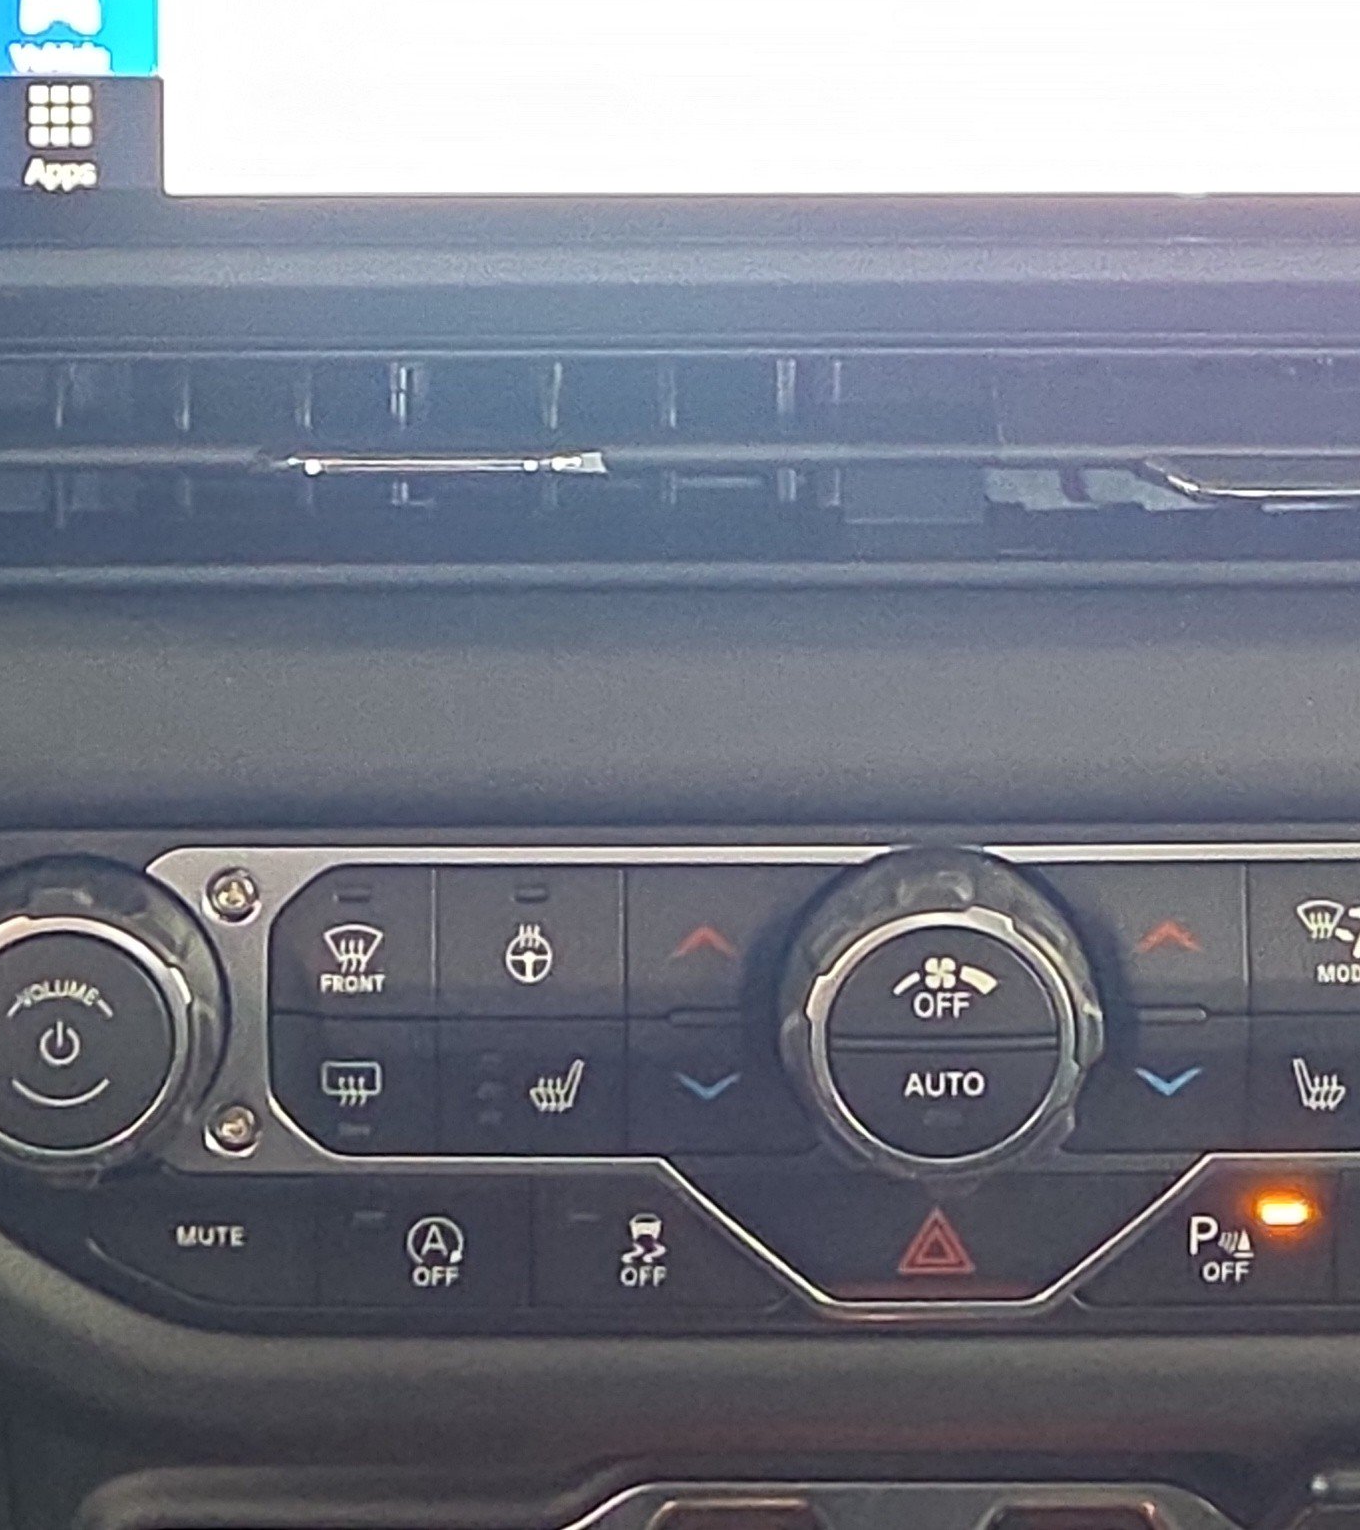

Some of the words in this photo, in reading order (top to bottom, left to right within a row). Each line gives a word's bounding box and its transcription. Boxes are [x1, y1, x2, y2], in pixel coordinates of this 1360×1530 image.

[25, 158, 97, 191] Apps
[16, 982, 96, 1008] VOLUME
[321, 974, 384, 993] FRONT
[913, 992, 970, 1018] OFF
[903, 1072, 985, 1098] AUTO
[176, 1225, 245, 1247] MUTE
[412, 1267, 459, 1287] OFF
[620, 1266, 666, 1287] OFF
[1202, 1260, 1249, 1283] OFF
